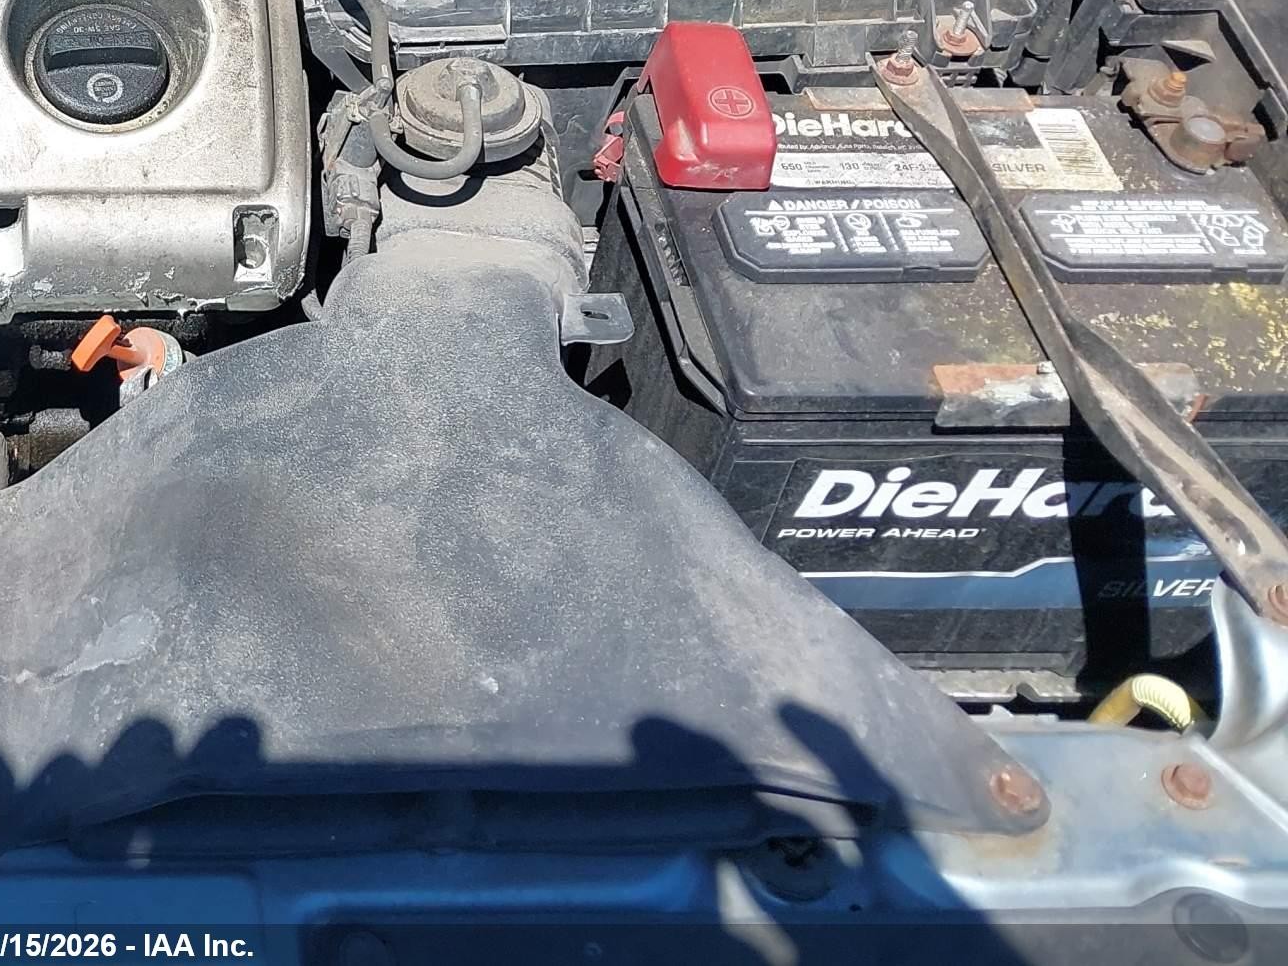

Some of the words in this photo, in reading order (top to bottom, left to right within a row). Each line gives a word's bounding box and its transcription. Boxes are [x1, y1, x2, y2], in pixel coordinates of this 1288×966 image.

[991, 162, 1047, 174] SILVER
[783, 199, 849, 210] DANGER
[863, 198, 922, 210] POISON
[778, 528, 876, 538] POWER
[881, 528, 980, 538] AHEAD
